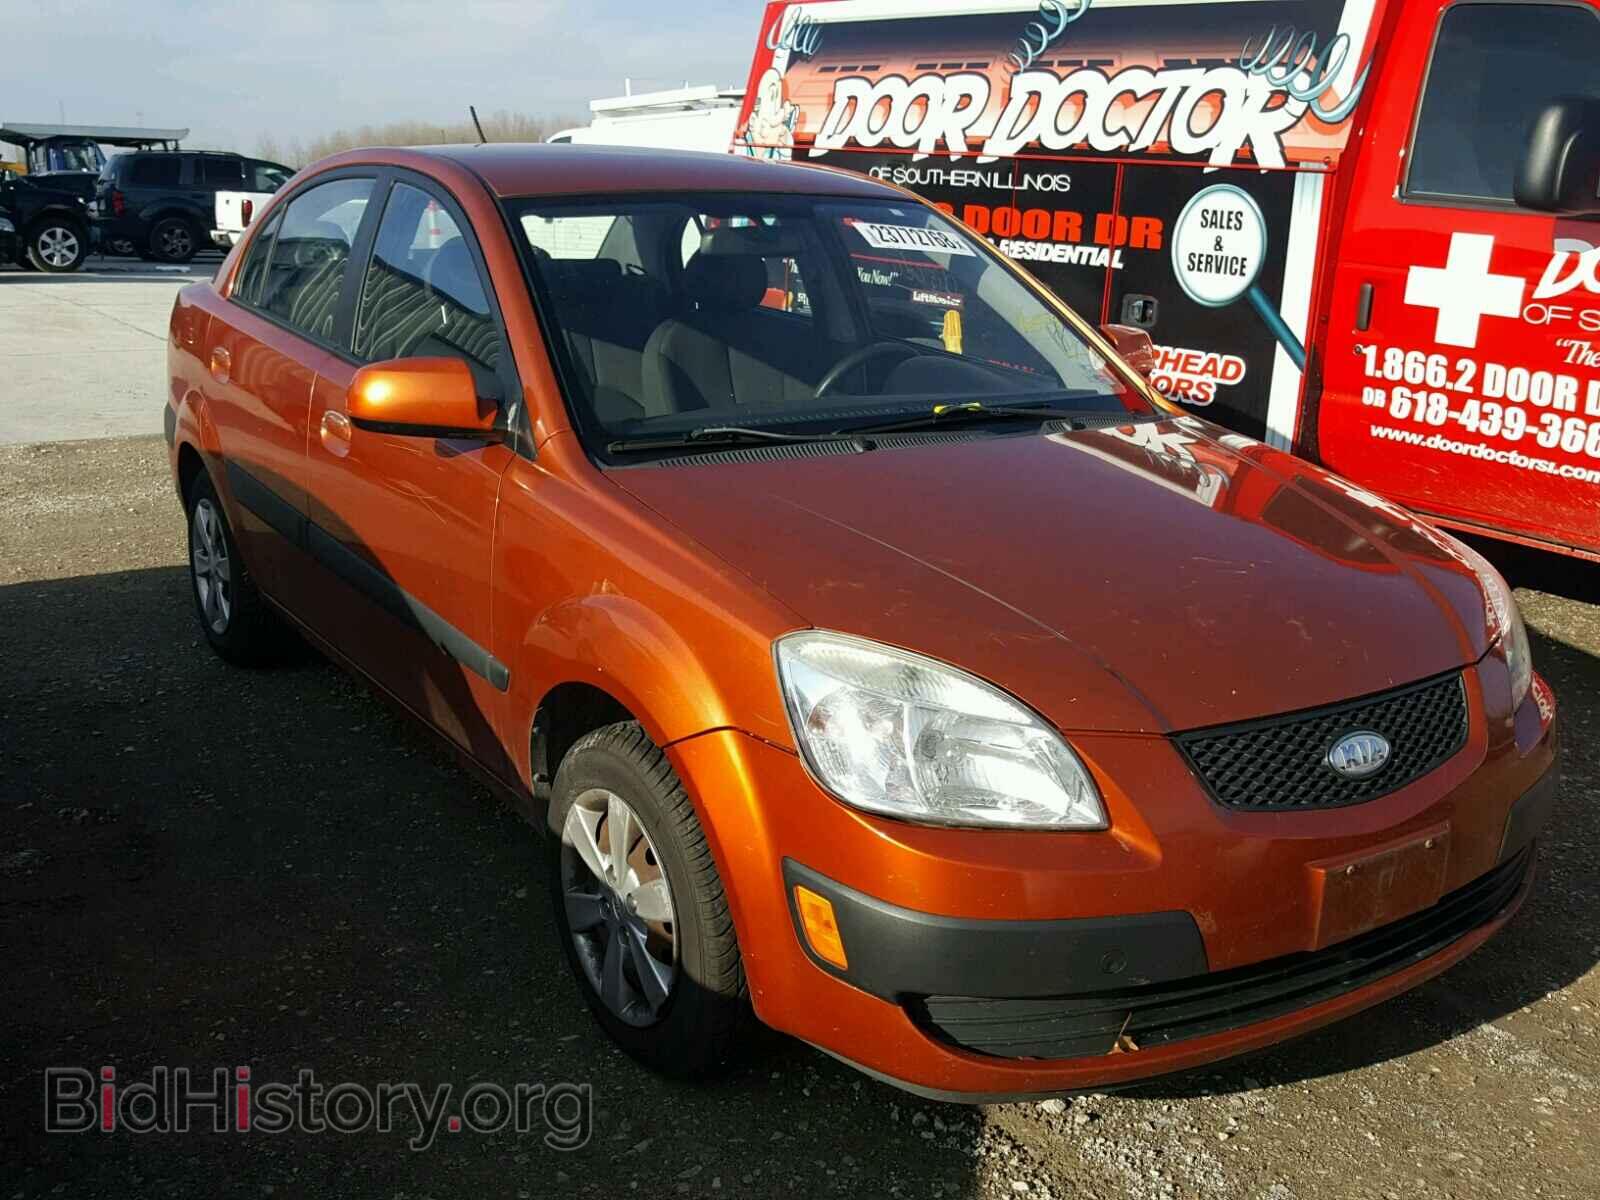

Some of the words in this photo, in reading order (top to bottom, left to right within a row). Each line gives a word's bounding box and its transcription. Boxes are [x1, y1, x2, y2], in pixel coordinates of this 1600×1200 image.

[808, 73, 991, 162] DOOR
[983, 65, 1311, 176] DOCTOR
[869, 166, 893, 183] OF
[893, 167, 991, 188] SOUTHERN
[992, 172, 1071, 192] ILLINOIS
[963, 204, 1082, 242] DOOR
[1094, 213, 1163, 249] DR
[1200, 208, 1243, 231] SALES
[1000, 238, 1124, 270] RESIDENTIAL
[1214, 235, 1223, 252] &
[1187, 252, 1247, 277] SERVICE
[1523, 303, 1574, 325] OF
[1362, 344, 1477, 394] 1.866.2
[1482, 362, 1579, 413] DOOR
[1362, 386, 1387, 408] OR
